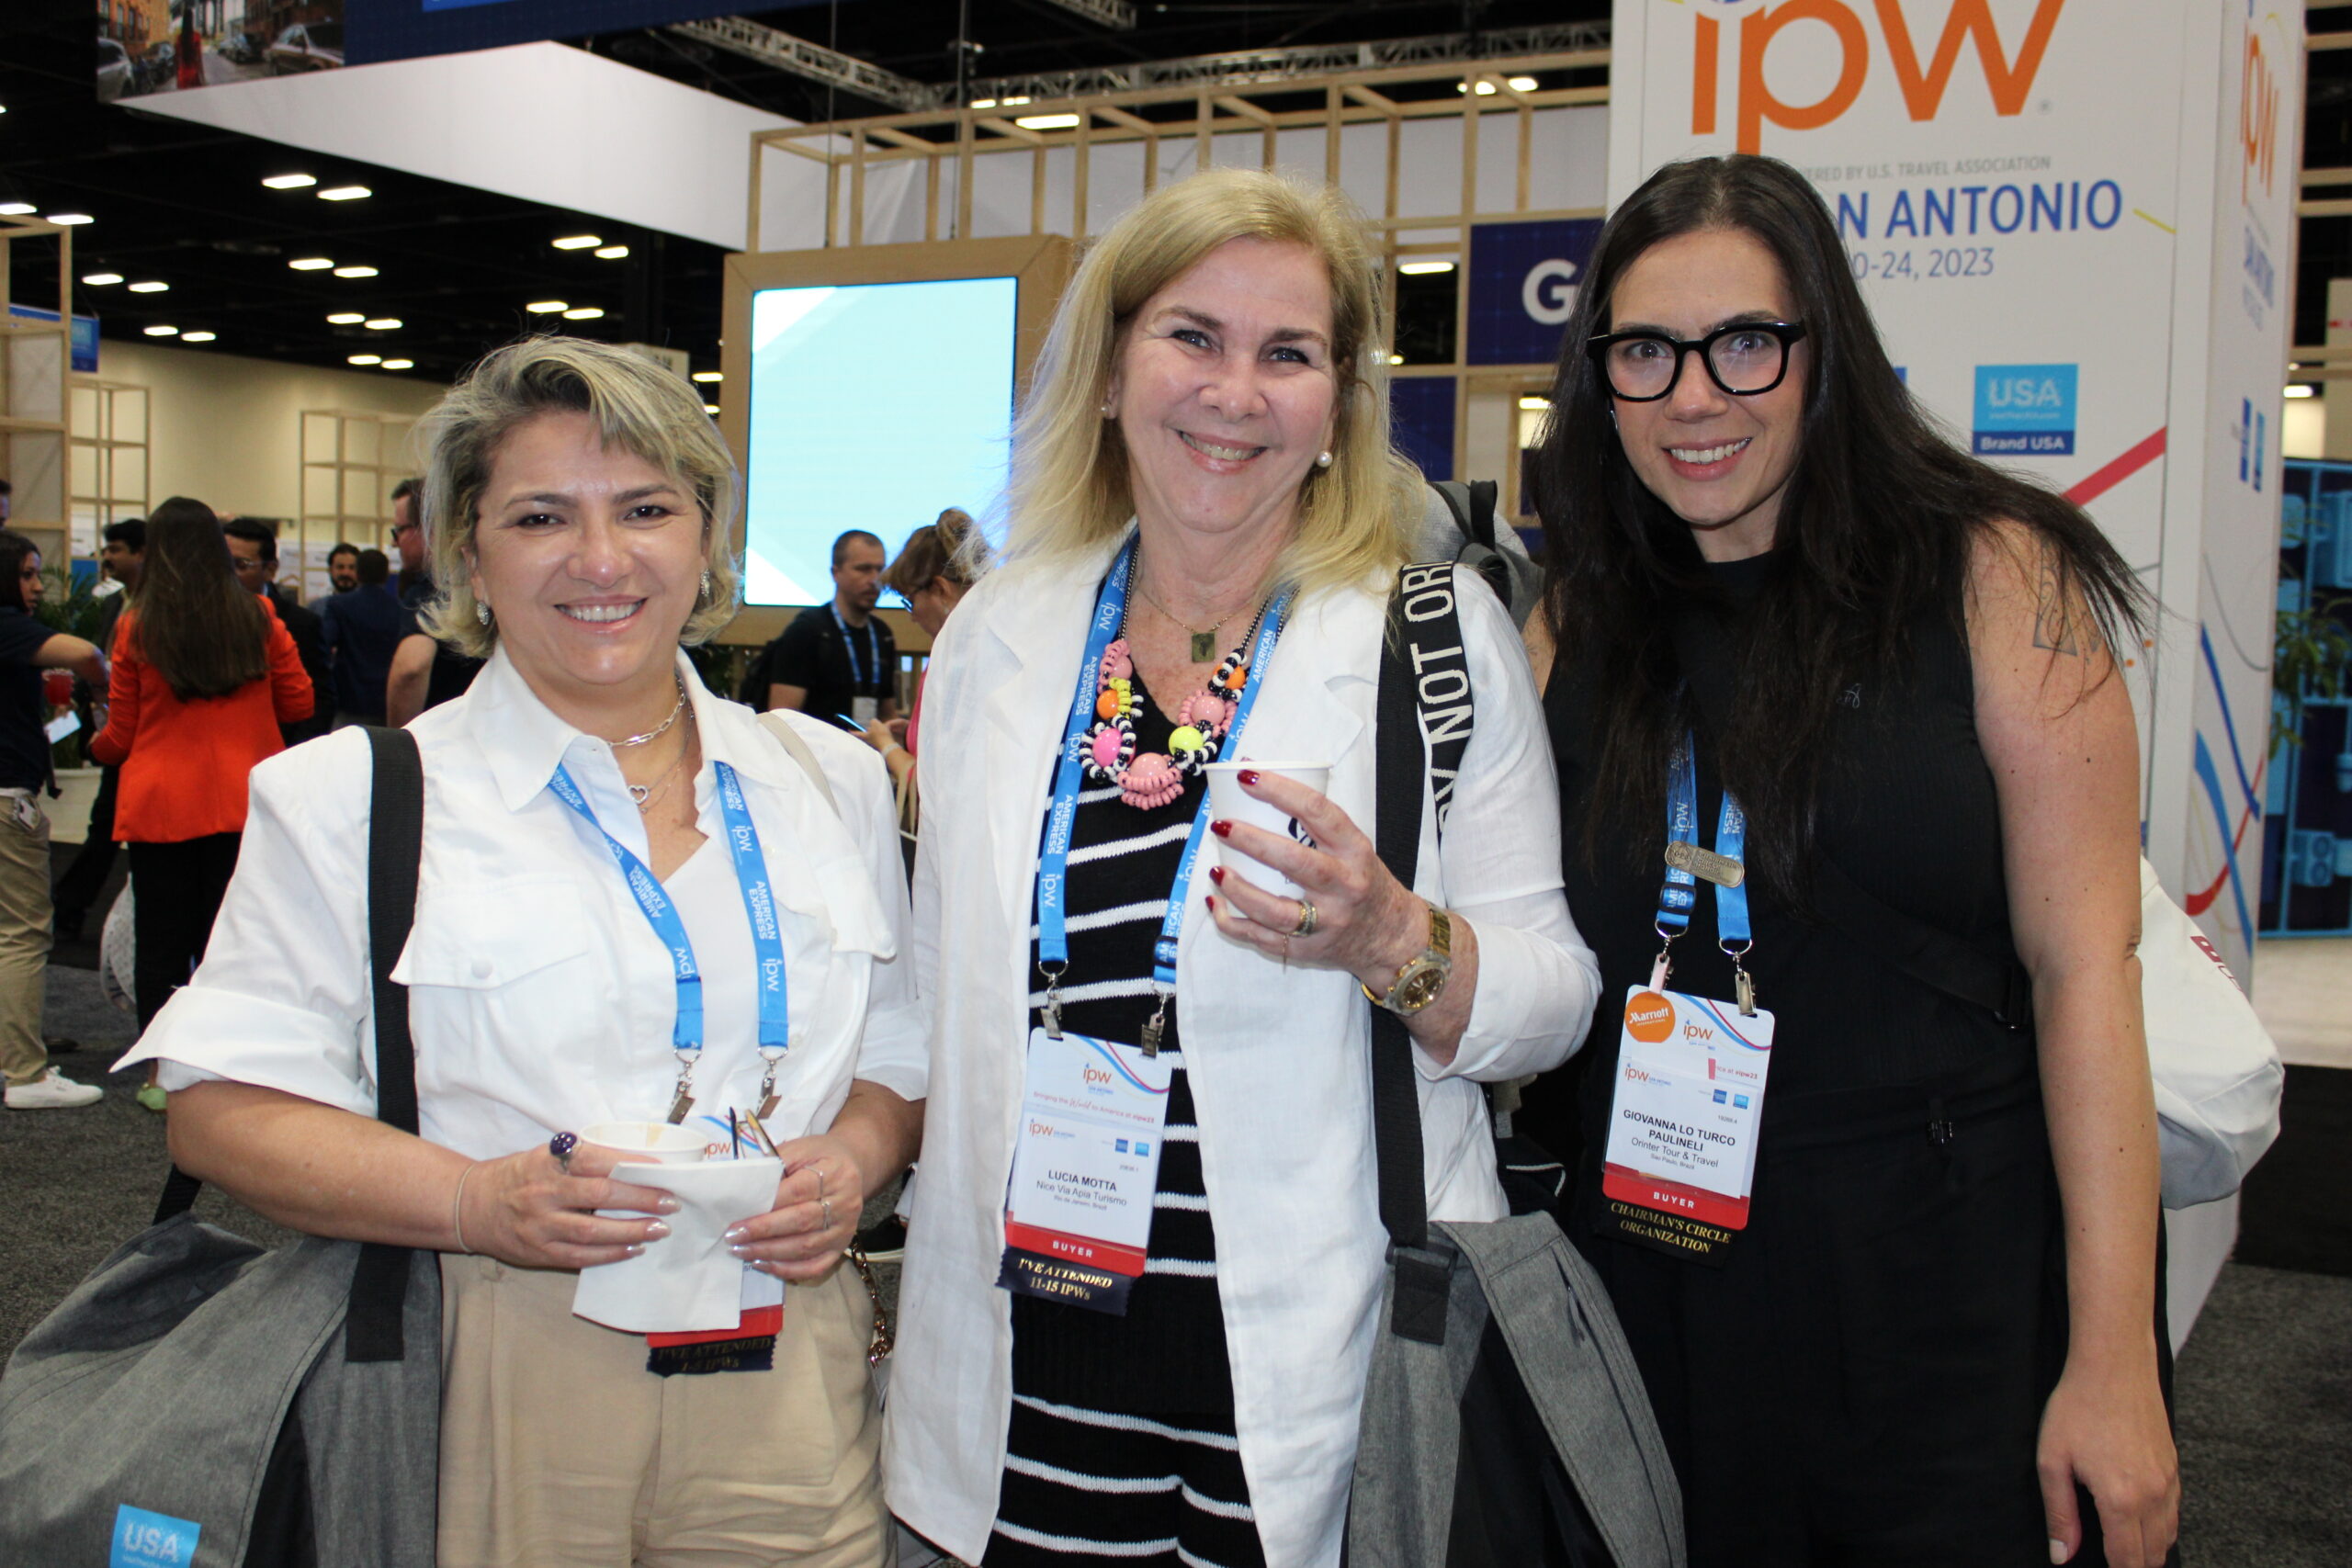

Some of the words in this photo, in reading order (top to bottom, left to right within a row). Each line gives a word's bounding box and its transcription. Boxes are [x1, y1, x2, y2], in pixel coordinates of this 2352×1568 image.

[1691, 0, 2065, 155] ipw
[1804, 165, 1842, 182] ERED
[1846, 166, 1863, 181] BY
[1867, 164, 1894, 180] U.S.
[1898, 161, 1950, 178] TRAVEL
[1954, 155, 2052, 176] ASSOCIATION
[1884, 178, 2123, 239] ANTONIO
[1853, 251, 1920, 282] 0-24,
[1928, 247, 1996, 277] 2023
[1988, 378, 2063, 407] USA
[1980, 436, 2028, 451] Brand
[2030, 435, 2065, 451] USA
[1099, 602, 1123, 631] ipw
[1252, 628, 1275, 684] AMERICAN
[1075, 664, 1091, 716] EXPRESS
[1081, 656, 1098, 716] AMERICAN
[1409, 642, 1474, 745] NOT
[1067, 732, 1081, 762] ipw
[732, 825, 753, 852] ipw
[1047, 802, 1065, 855] EXPRESS
[1056, 794, 1074, 855] AMERICAN
[628, 869, 662, 919] AMERICAN
[634, 864, 667, 908] EXPRESS
[1042, 874, 1062, 908] ipw
[749, 888, 768, 941] EXPRESS
[755, 880, 777, 941] AMERICAN
[673, 947, 695, 980] ipw
[762, 958, 782, 992] ipw
[1629, 1007, 1669, 1025] Marriott
[1683, 1021, 1713, 1040] ipw
[1083, 1067, 1112, 1084] ipw
[1624, 1066, 1650, 1082] ipw
[1029, 1122, 1054, 1137] ipw
[1623, 1109, 1677, 1132] GIOVANNA
[1679, 1123, 1694, 1136] LO
[1697, 1128, 1736, 1146] TURCO
[1648, 1129, 1704, 1152] PAULINELI
[704, 1142, 732, 1159] ipw
[1631, 1136, 1660, 1153] Orinter
[1663, 1145, 1680, 1157] Tour
[1682, 1151, 1690, 1160] &
[1692, 1153, 1719, 1168] Travel
[1036, 1180, 1056, 1191] Nice
[1057, 1184, 1070, 1195] Via
[1072, 1188, 1091, 1200] Apia
[1093, 1190, 1127, 1207] Turismo
[1048, 1169, 1080, 1184] LUCIA
[1080, 1176, 1117, 1192] MOTTA
[1653, 1191, 1695, 1209] BUYER
[1611, 1201, 1685, 1231] CHAIRMAN'S
[1686, 1223, 1732, 1244] CIRCLE
[1620, 1219, 1712, 1253] ORGANIZATION
[1052, 1240, 1093, 1258] BUYER
[1018, 1258, 1045, 1274] I'VE
[1045, 1266, 1114, 1289] ATTENDED
[1030, 1276, 1059, 1293] 11-15
[1059, 1282, 1091, 1302] IPWs
[122, 1520, 180, 1563] USA
